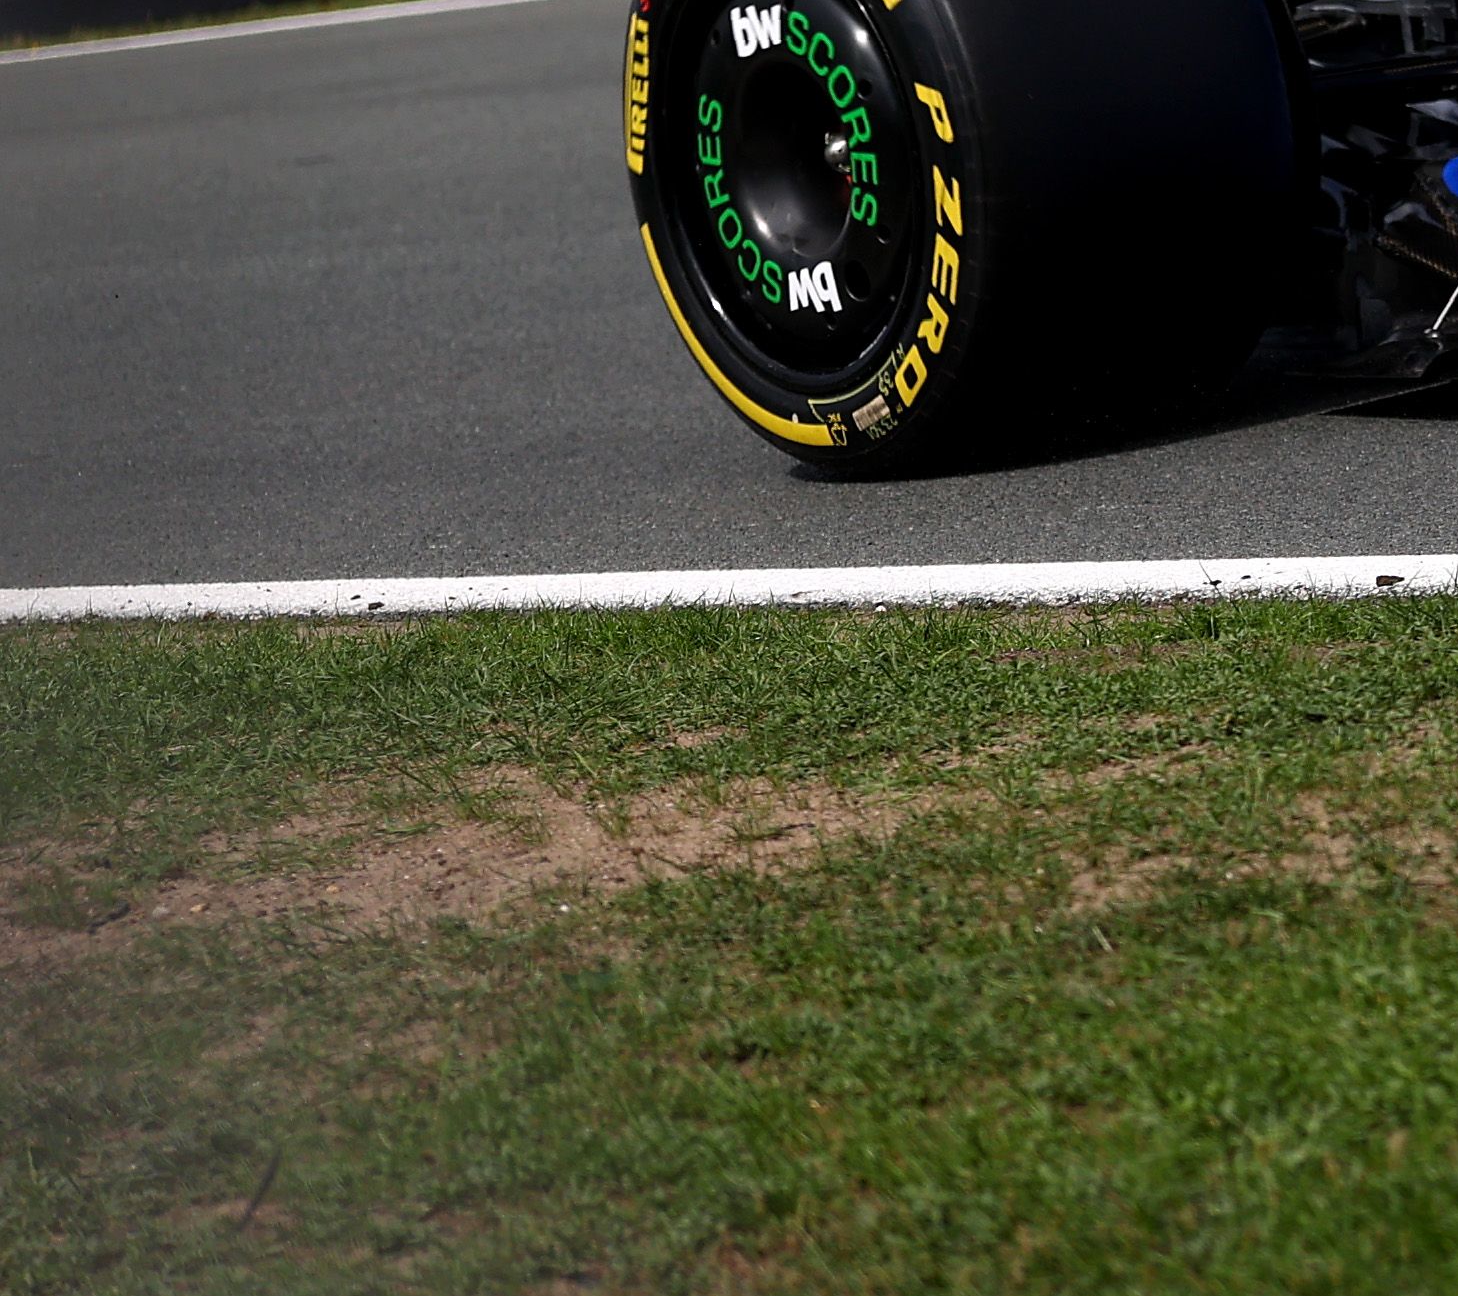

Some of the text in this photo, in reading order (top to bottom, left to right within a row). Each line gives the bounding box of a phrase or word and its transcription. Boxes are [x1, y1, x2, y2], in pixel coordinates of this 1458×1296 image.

[622, 11, 650, 177] PIRELLI
[698, 93, 843, 313] bw SCORES
[730, 3, 879, 227] bw SCORES
[894, 82, 963, 408] P ZERO
